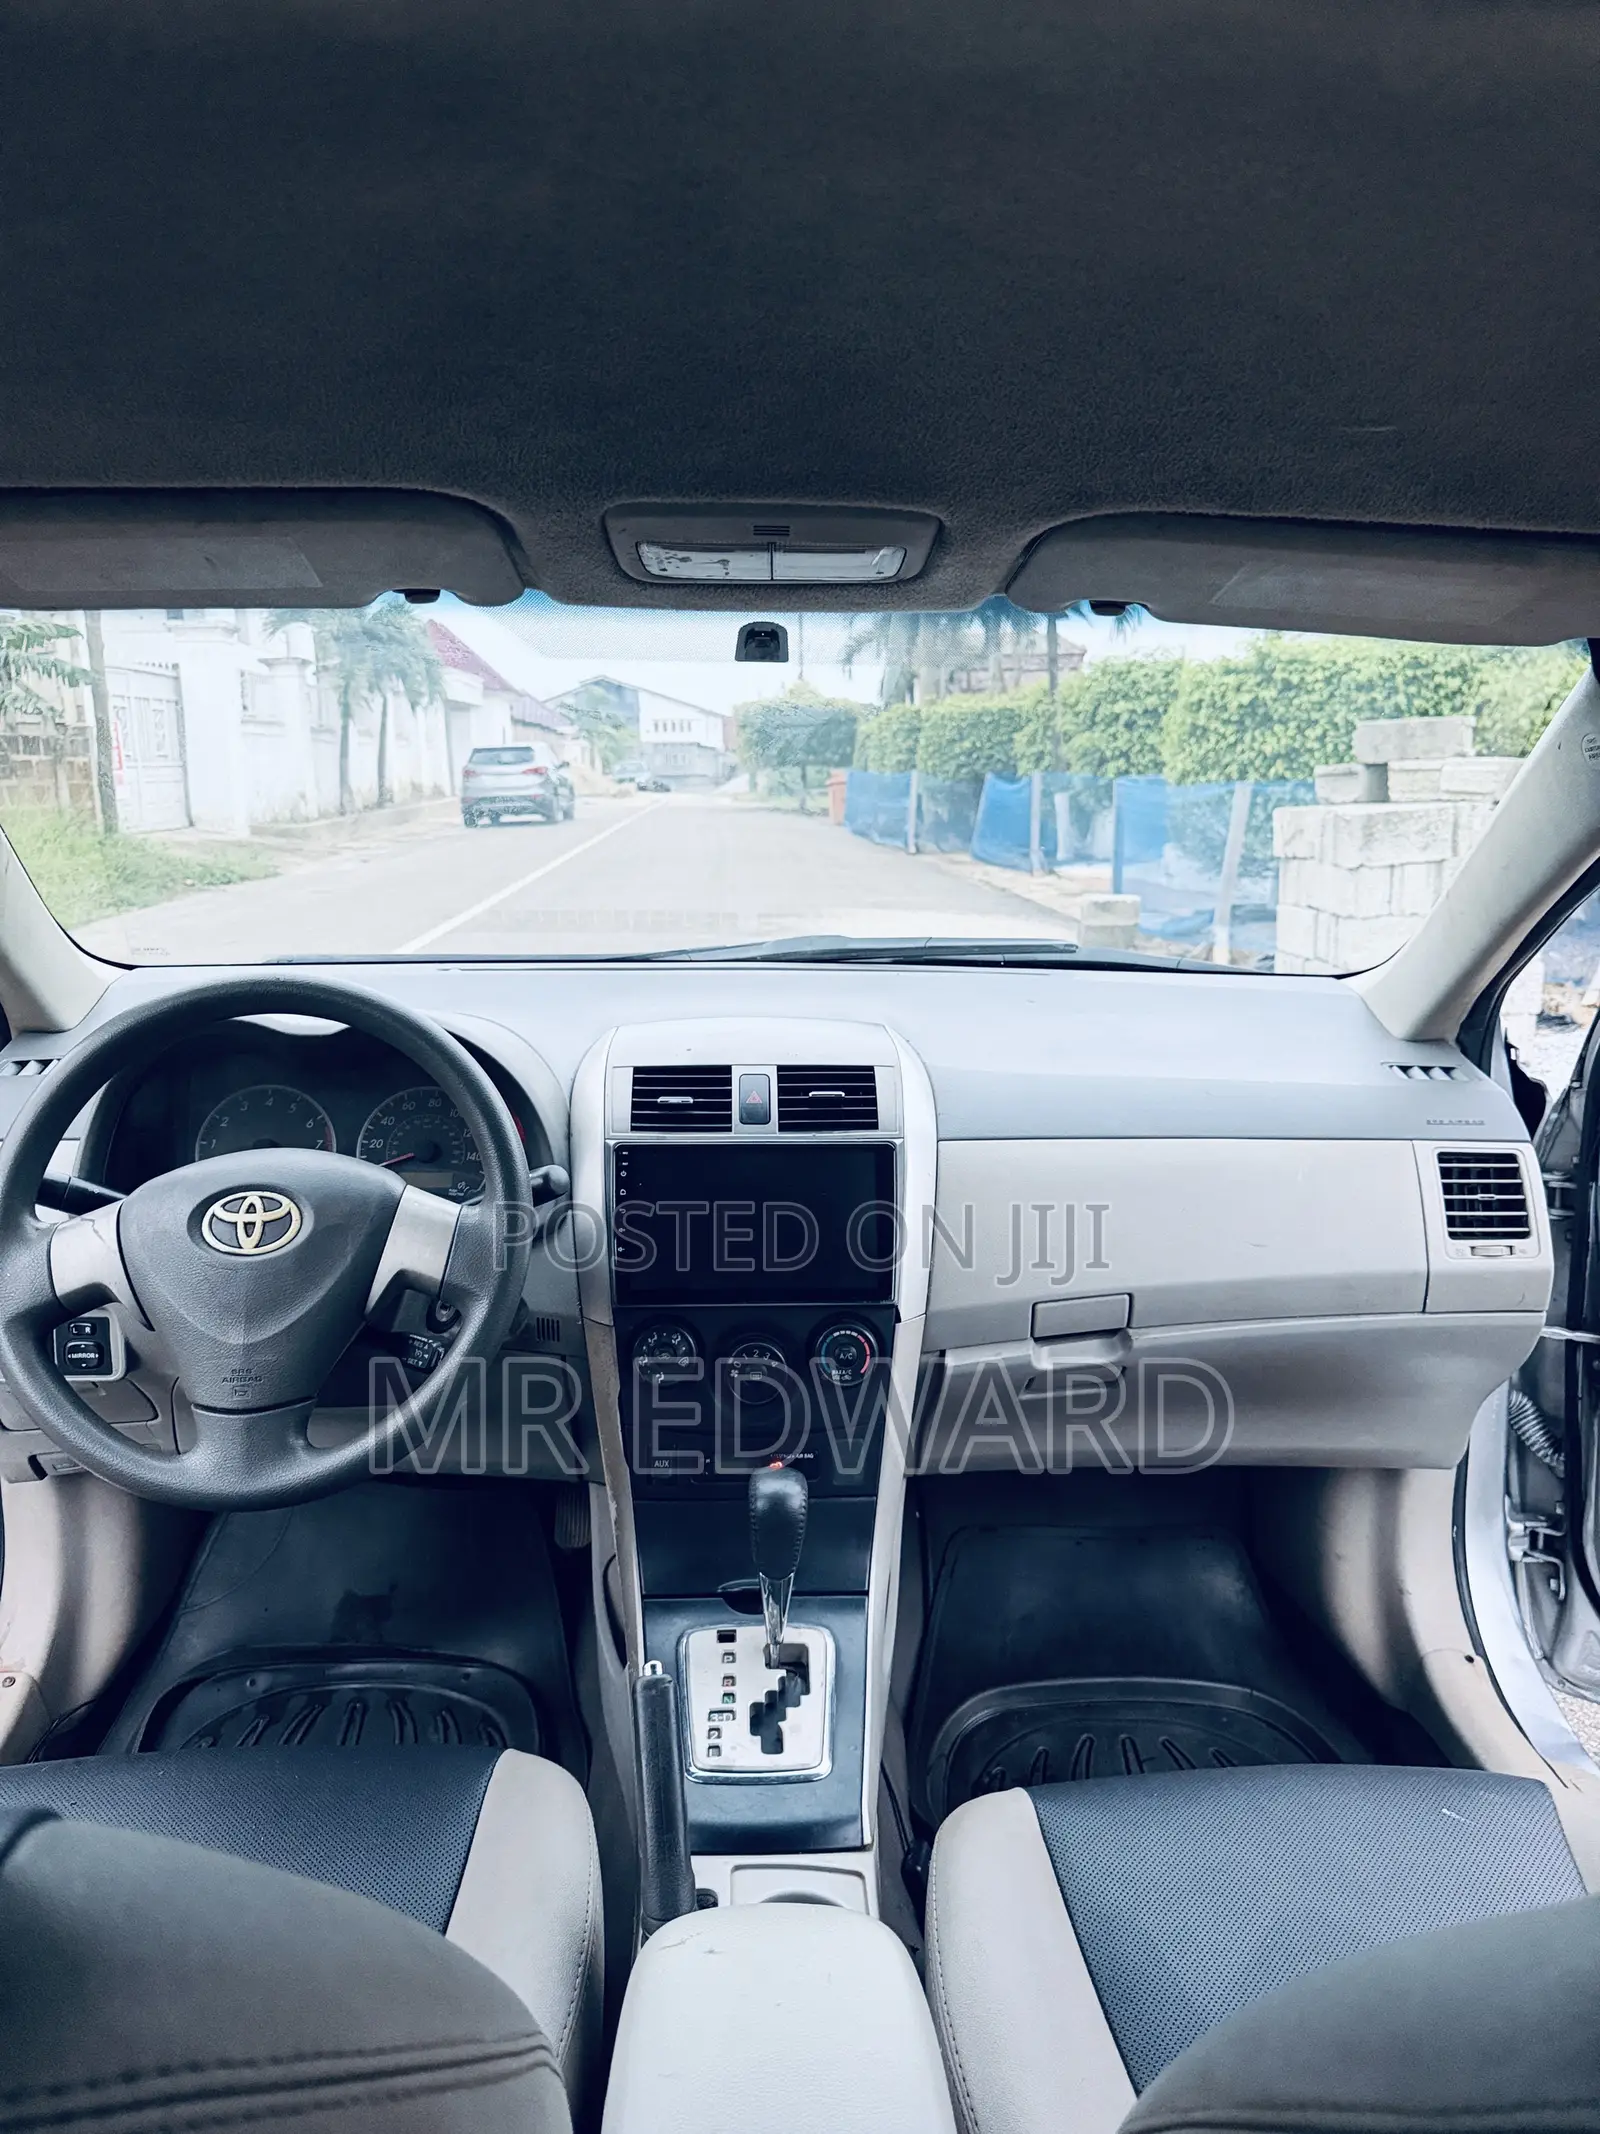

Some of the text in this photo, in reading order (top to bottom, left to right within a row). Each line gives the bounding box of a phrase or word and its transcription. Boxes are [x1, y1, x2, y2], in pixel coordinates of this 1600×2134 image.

[240, 1101, 249, 1112] 3
[264, 1097, 274, 1107] 4
[402, 1101, 416, 1111] 60
[428, 1098, 442, 1108] 80
[287, 1103, 297, 1113] 5
[220, 1116, 231, 1127] 2
[306, 1119, 314, 1128] 6
[380, 1116, 395, 1126] 40
[210, 1139, 217, 1150] 1
[315, 1139, 324, 1150] 7
[369, 1139, 384, 1149] 20
[753, 1349, 760, 1358] 2
[763, 1352, 771, 1361] 3
[654, 1460, 670, 1468] AUX
